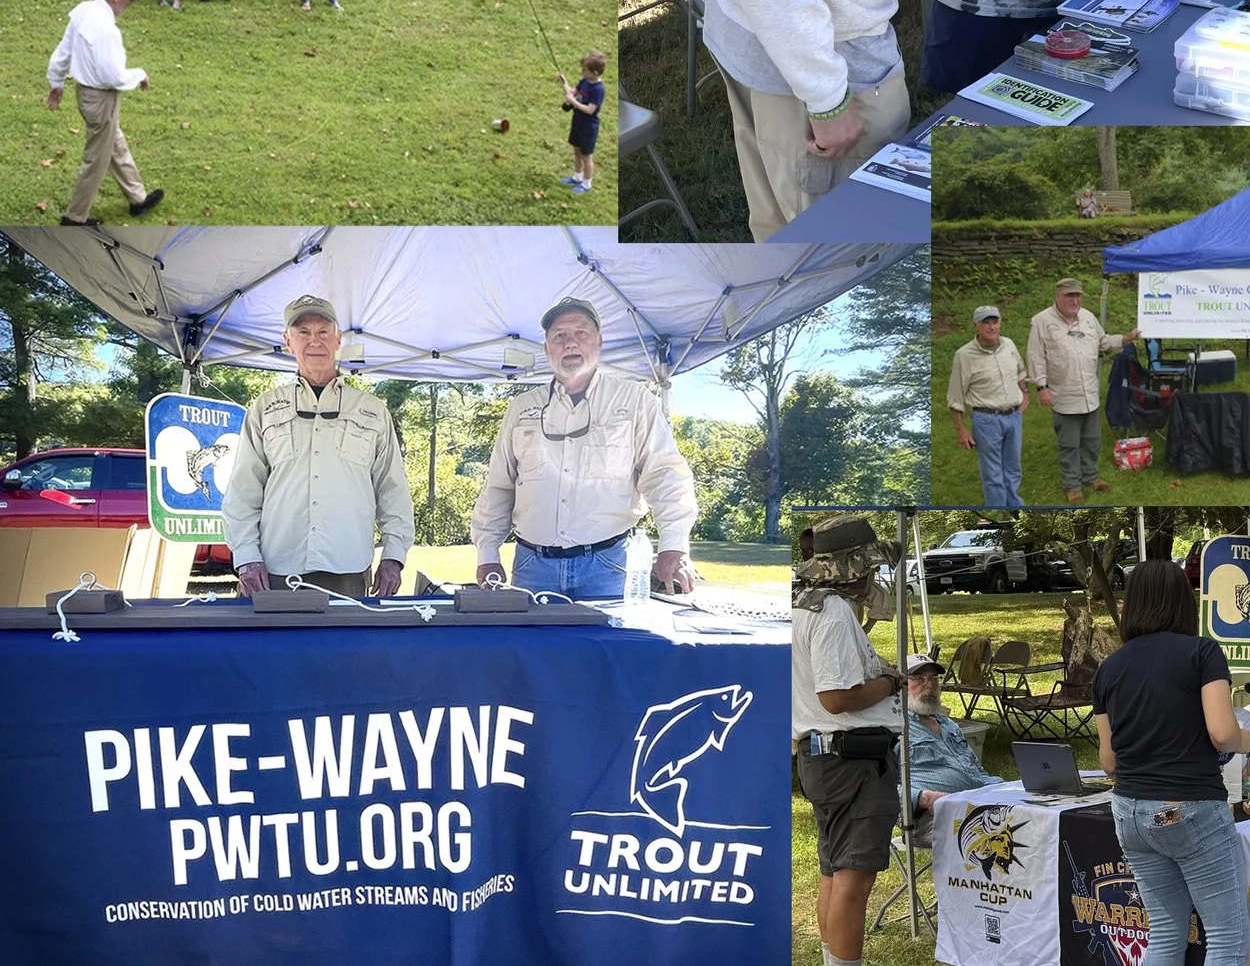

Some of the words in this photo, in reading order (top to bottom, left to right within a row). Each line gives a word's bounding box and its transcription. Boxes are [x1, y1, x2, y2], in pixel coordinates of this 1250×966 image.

[1002, 78, 1070, 104] IDENTIFICATION
[1010, 90, 1063, 112] GUIDE
[1176, 284, 1198, 295] Pike
[1208, 284, 1243, 297] Wayne
[1144, 300, 1172, 310] TROUT
[1197, 302, 1234, 311] TROUT
[179, 404, 231, 428] TROUT
[164, 517, 224, 535] UNLIMI
[84, 705, 534, 813] PIKE-WAYNE
[169, 800, 472, 886] PWTU.ORG
[570, 830, 763, 877] TROUT
[1094, 862, 1114, 877] FIN
[105, 899, 225, 923] CONSERVATION
[230, 895, 250, 915] OF
[253, 892, 294, 912] COLD
[297, 888, 352, 911] WATER
[355, 885, 429, 906] STREAMS
[432, 886, 458, 913] AND
[462, 874, 515, 912] FISHERIES
[564, 870, 755, 904] UNLIMITED
[948, 876, 1033, 900] MANHATTAN
[980, 892, 1007, 905] CUP
[1071, 894, 1150, 929] WARRI
